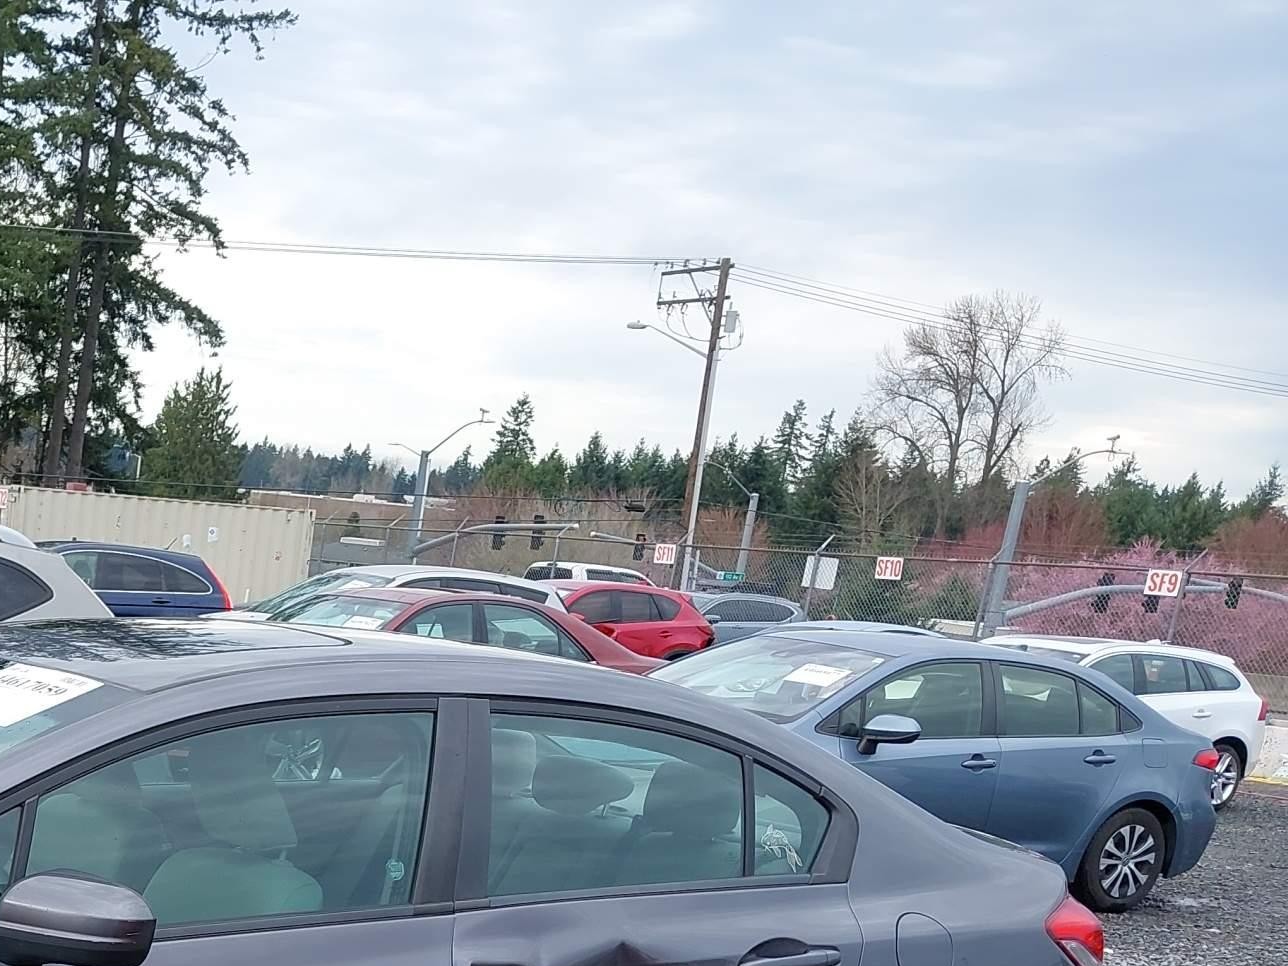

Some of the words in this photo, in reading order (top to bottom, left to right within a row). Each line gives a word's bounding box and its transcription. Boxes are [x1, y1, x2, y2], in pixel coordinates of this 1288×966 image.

[656, 545, 674, 561] SF11
[876, 560, 902, 577] SF10
[1148, 572, 1179, 593] SF9
